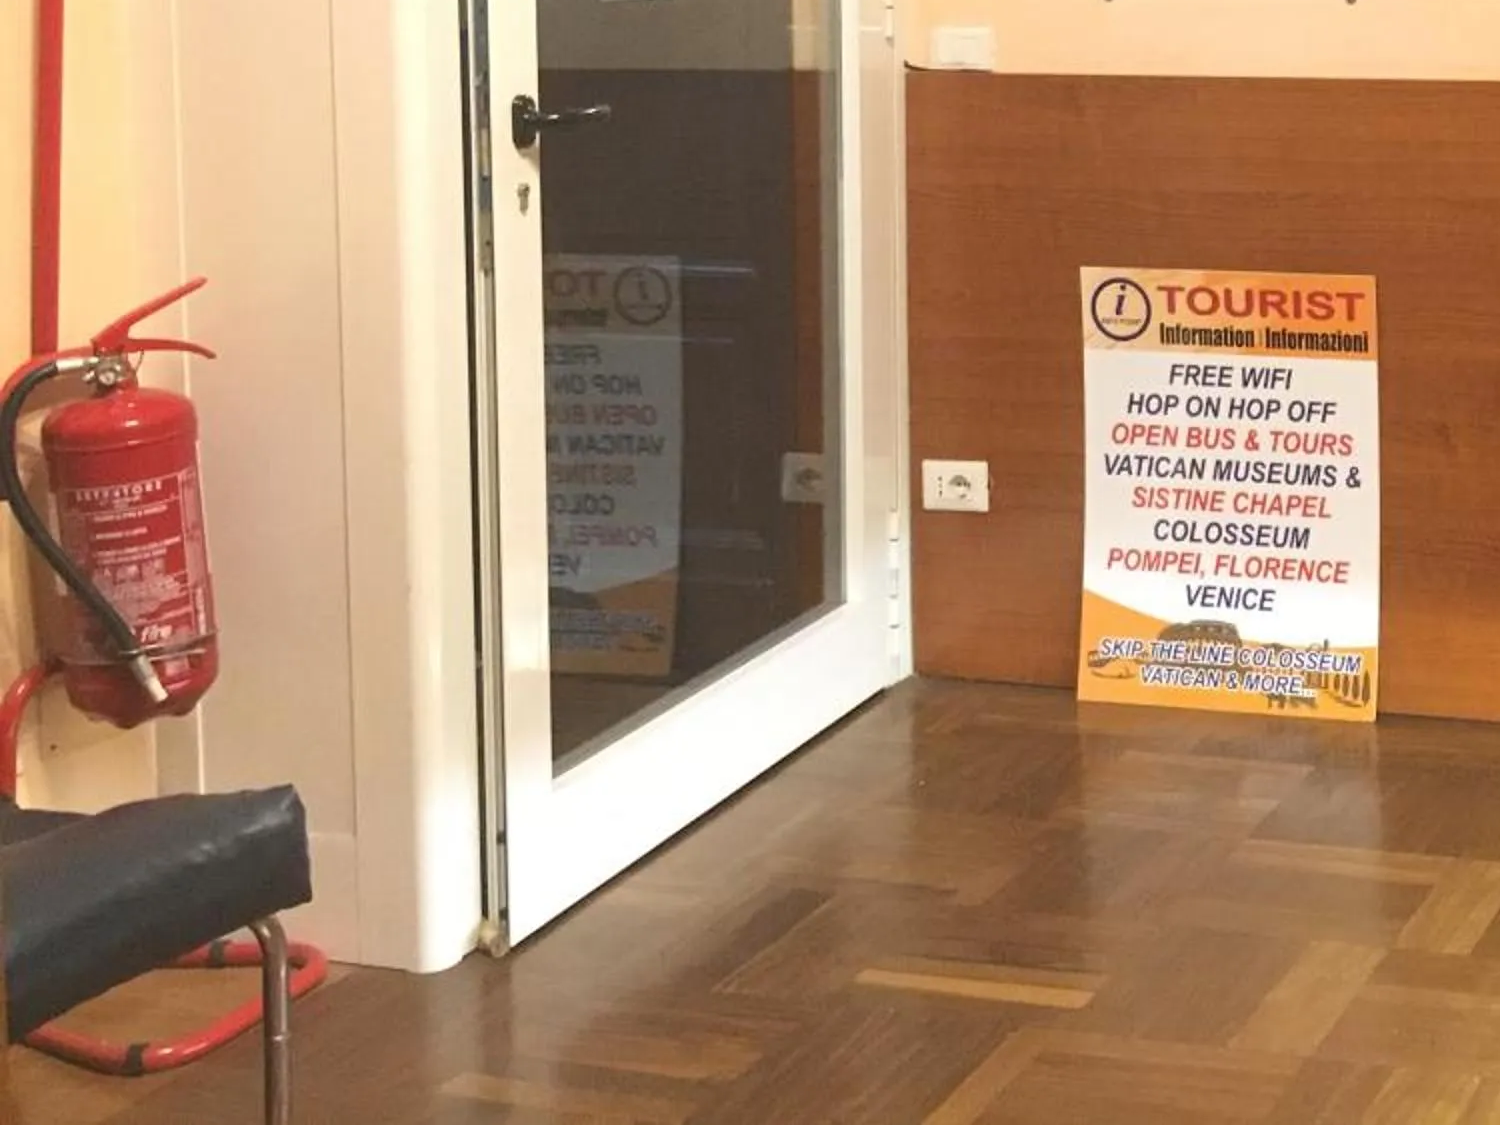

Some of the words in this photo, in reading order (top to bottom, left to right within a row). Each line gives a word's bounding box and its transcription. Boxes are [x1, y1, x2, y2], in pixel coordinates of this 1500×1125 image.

[1157, 285, 1365, 322] TOURIST
[1159, 322, 1255, 348] Information
[1265, 326, 1369, 354] Informazioni
[1169, 364, 1234, 389] FREE
[1241, 367, 1293, 391] WIFI
[1127, 392, 1179, 416] HOP
[1185, 395, 1221, 418] ON
[1228, 398, 1281, 421] HOP
[1287, 401, 1338, 424] OFF
[1111, 423, 1179, 448] OPEN
[1185, 426, 1237, 451] BUS
[1243, 429, 1260, 452] &
[1269, 431, 1354, 457] TOURS
[1103, 454, 1206, 480] VATICAN
[1212, 459, 1338, 487] MUSEUMS
[1345, 466, 1361, 488] &
[1131, 487, 1226, 513] SISTINE
[1232, 491, 1332, 519] CHAPEL
[1153, 519, 1311, 550] COLOSSEUM
[1107, 547, 1206, 579] POMPEI,
[1213, 554, 1351, 584] FLORENCE
[1185, 584, 1276, 612] VENICE
[1100, 638, 1144, 657] SKIP
[1149, 641, 1186, 660] THE
[1190, 643, 1233, 664] LINE
[1239, 647, 1362, 673] COLOSSEUM
[1141, 666, 1220, 688] VATICAN
[1226, 671, 1238, 690] &
